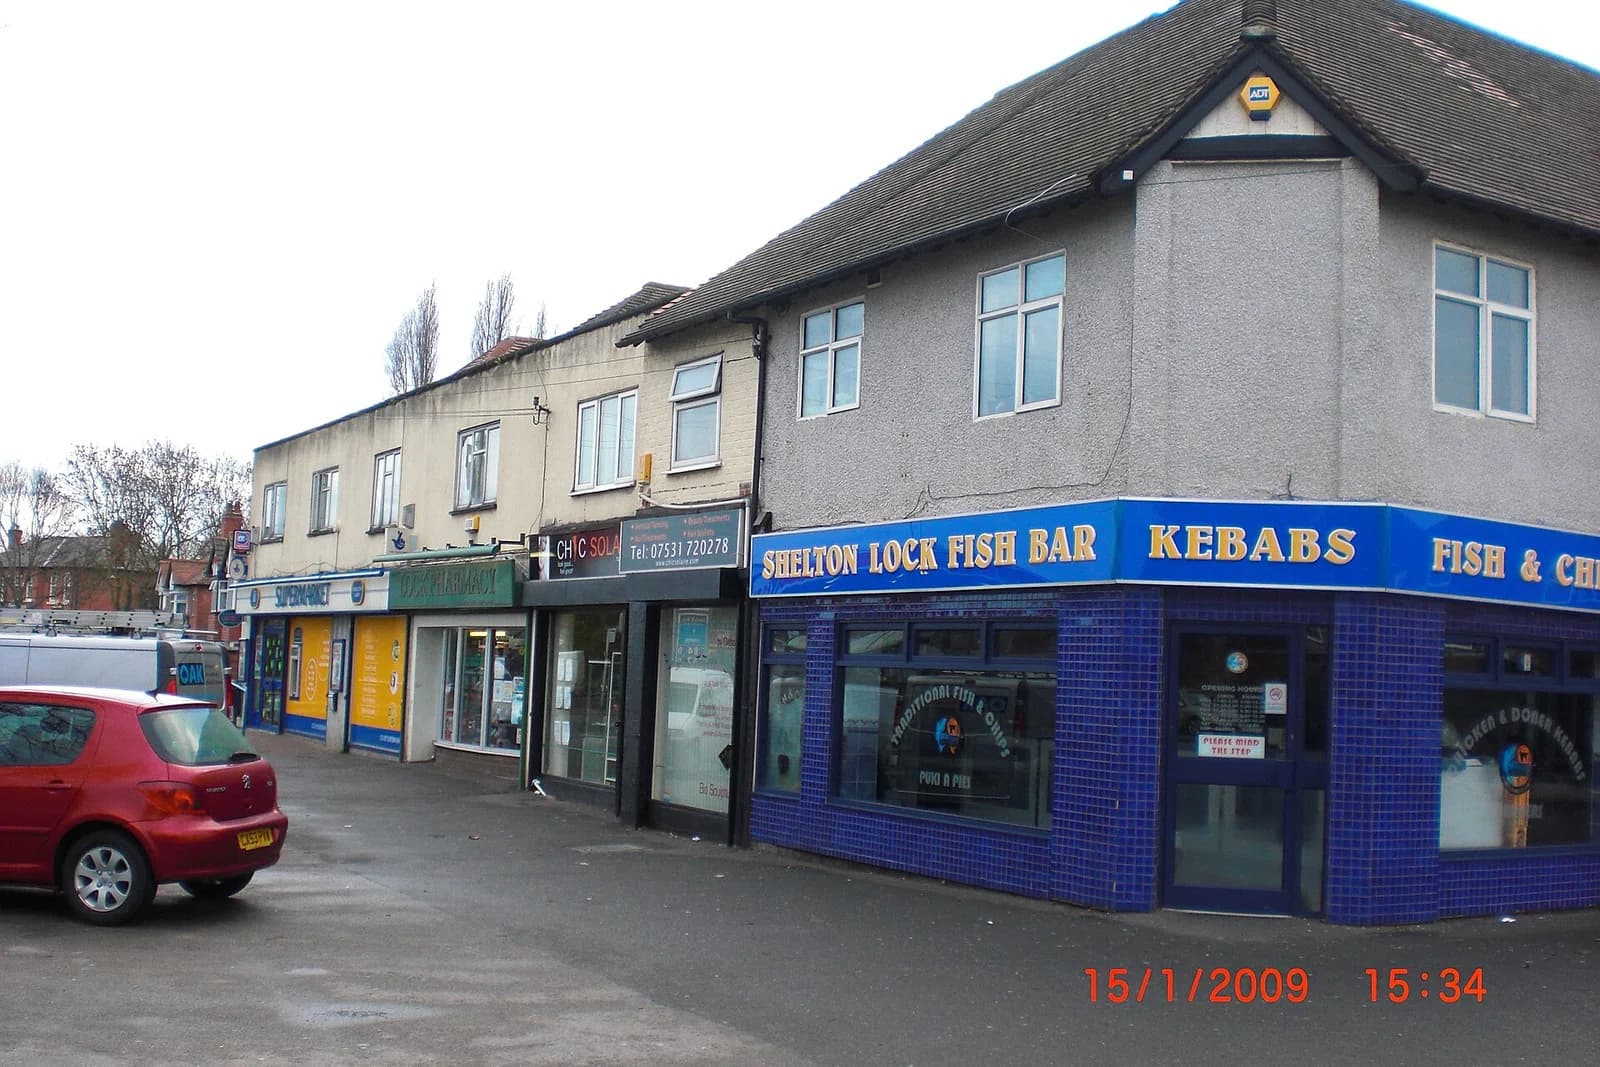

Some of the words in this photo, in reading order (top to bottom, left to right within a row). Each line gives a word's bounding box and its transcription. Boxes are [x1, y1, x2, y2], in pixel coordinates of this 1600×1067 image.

[1250, 88, 1269, 99] ADT
[630, 544, 648, 560] Tel:
[651, 541, 682, 559] 07531
[687, 537, 729, 556] 720278
[761, 544, 858, 580] SHELTON
[869, 537, 938, 574] LOCK
[947, 530, 1017, 569] FISH
[1029, 524, 1097, 564] BAR
[1149, 524, 1357, 565] KEBABS
[1432, 537, 1506, 579] FISH
[1520, 549, 1542, 583] &
[429, 568, 496, 595] PHARMACY
[275, 582, 332, 607] SUPERMARKET
[180, 664, 203, 684] OAK
[891, 684, 950, 745] TRADITIONAL
[953, 686, 975, 706] FISH
[976, 700, 985, 716] &
[985, 712, 1010, 758] CHIPS
[1203, 737, 1233, 746] PLEASE
[1236, 738, 1260, 747] MIND
[1212, 747, 1227, 755] THE
[1231, 748, 1251, 756] STEP
